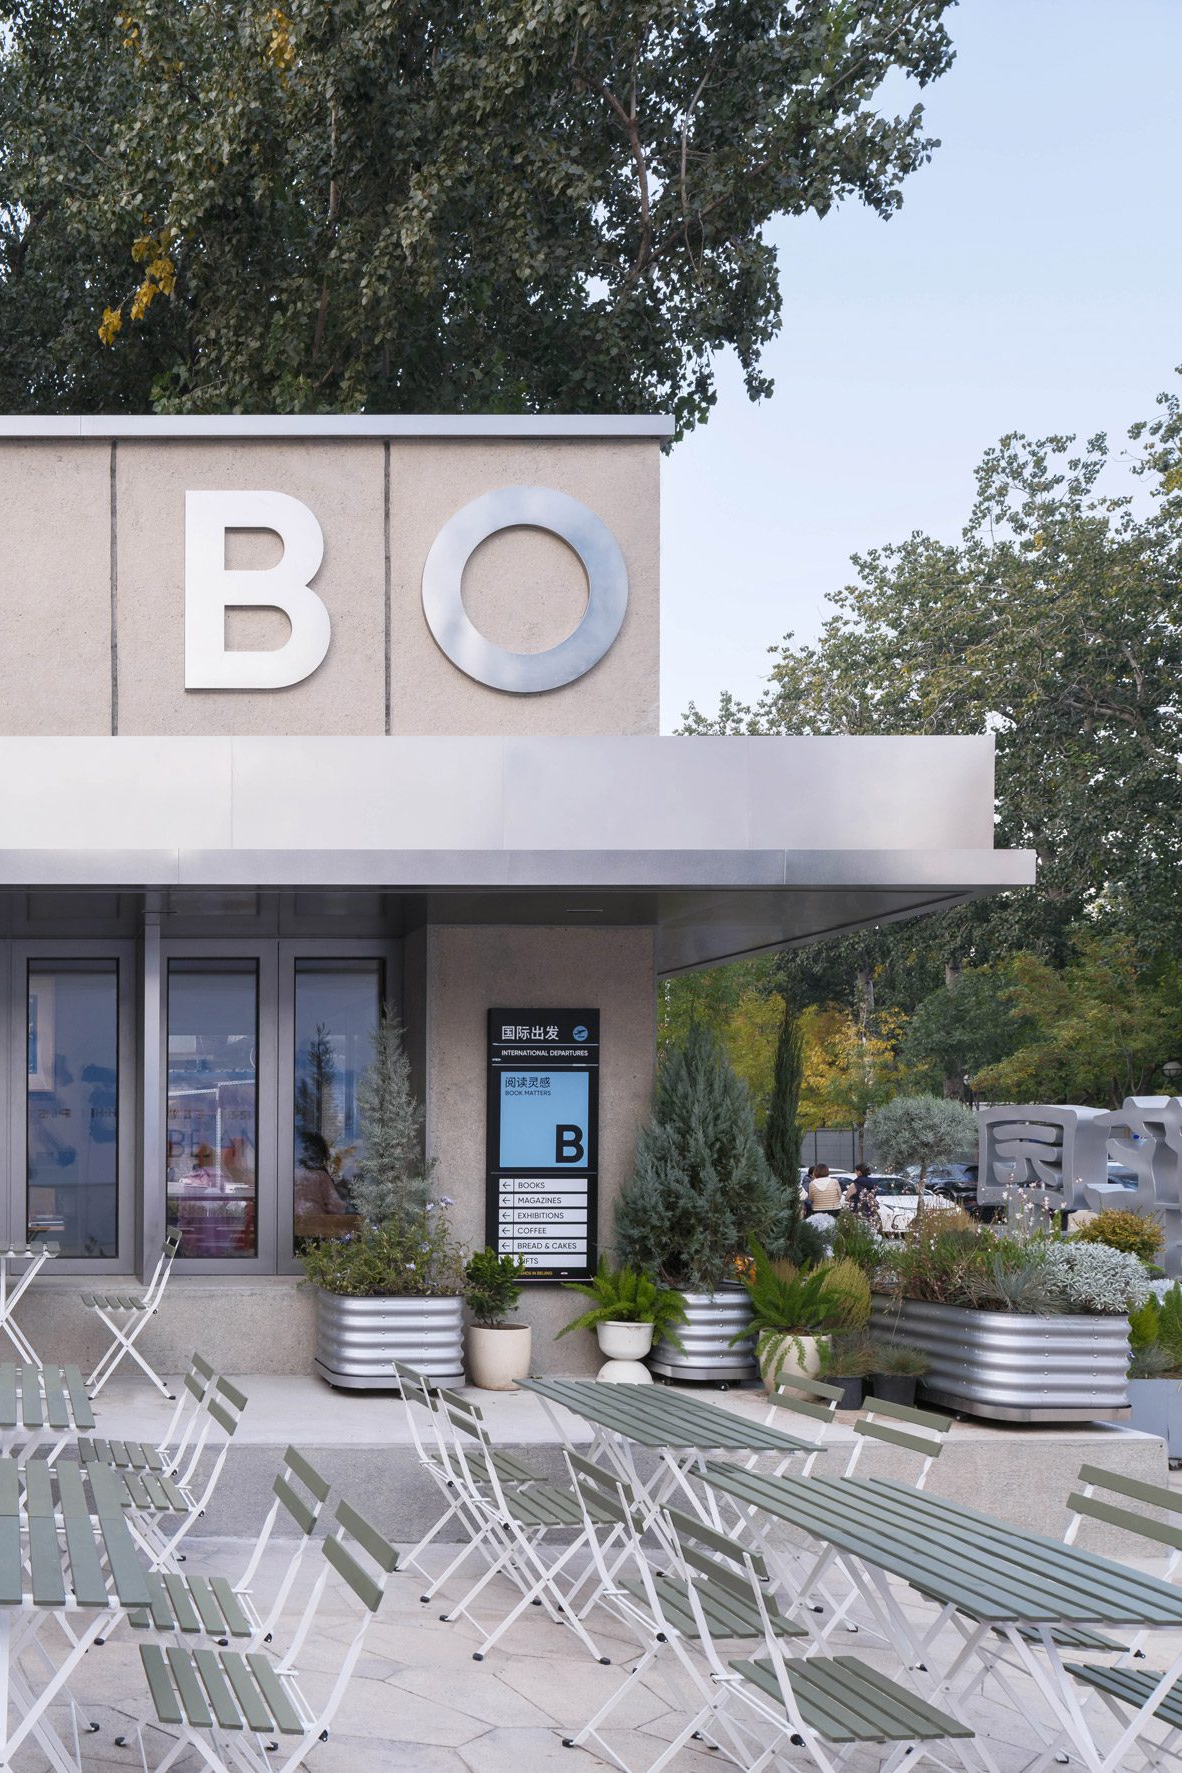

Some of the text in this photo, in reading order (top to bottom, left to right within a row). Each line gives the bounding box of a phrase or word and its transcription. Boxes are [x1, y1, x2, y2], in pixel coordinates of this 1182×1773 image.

[501, 1025, 559, 1040] 国际出发
[550, 1049, 589, 1057] DEPARTURES
[505, 1076, 551, 1088] 阅读灵感
[556, 1124, 584, 1163] B
[518, 1227, 547, 1235] COFFEE
[517, 1242, 577, 1250] BREAD & CAKES
[517, 1257, 539, 1265] IFTS
